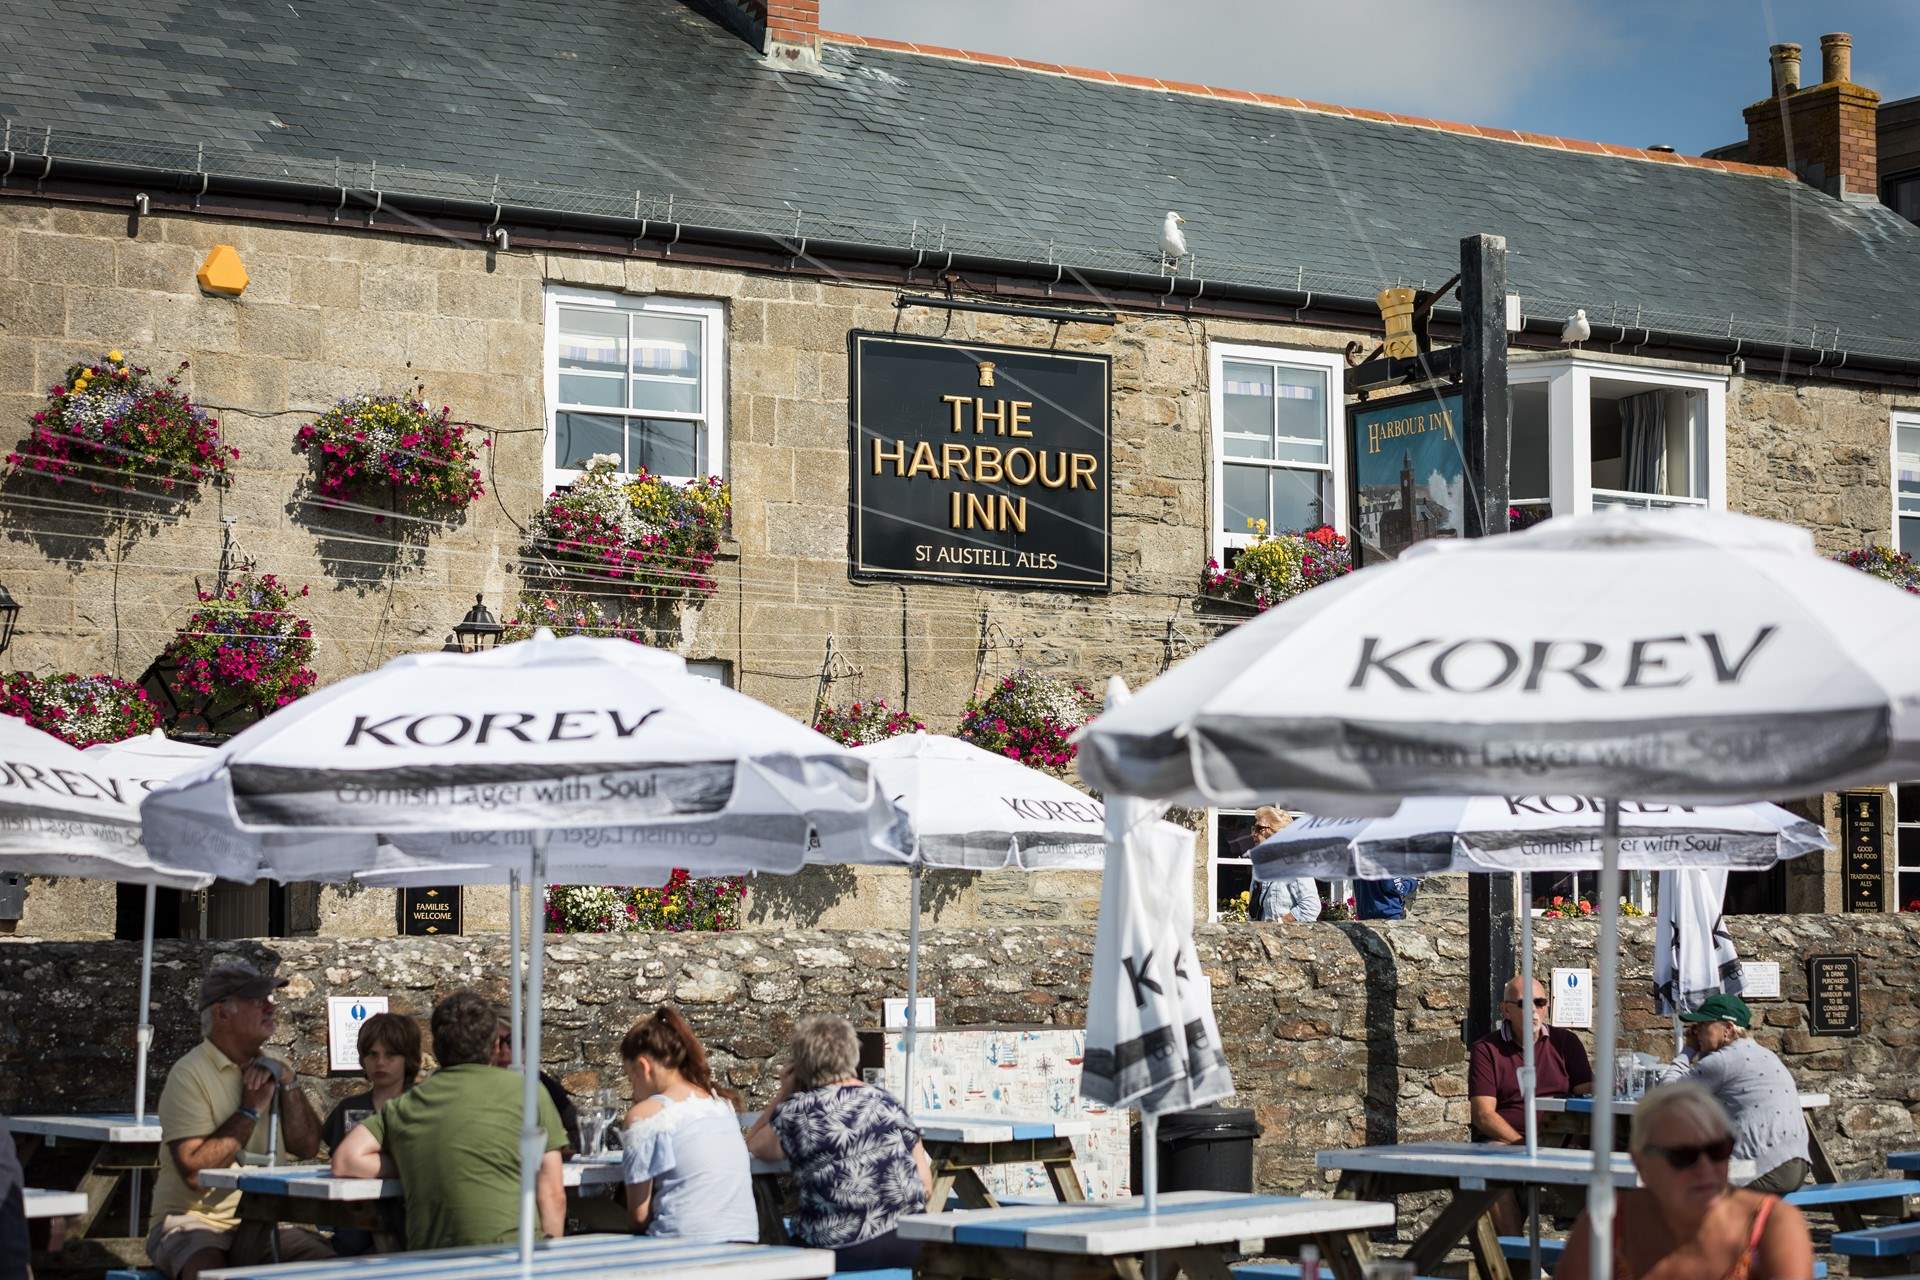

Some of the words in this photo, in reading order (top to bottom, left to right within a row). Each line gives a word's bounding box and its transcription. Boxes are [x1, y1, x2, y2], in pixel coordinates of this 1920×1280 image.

[943, 394, 1033, 438] THE
[1368, 415, 1425, 453] HARBOUR
[1429, 410, 1455, 440] INN
[872, 437, 1098, 490] HARBOUR
[951, 491, 1027, 532] INN
[936, 546, 1011, 567] AUSTELL
[1016, 551, 1058, 570] ALES
[1348, 625, 1778, 693] KOREV
[344, 707, 665, 747] KOREV
[336, 781, 439, 806] Cornish
[450, 780, 526, 810] Lager
[532, 776, 591, 803] with
[600, 773, 658, 799] Soul
[1520, 837, 1583, 855] Cornish
[1643, 835, 1680, 851] with
[1684, 834, 1722, 852] Soul
[414, 912, 452, 920] WELCOME
[416, 903, 449, 911] FAMILIES
